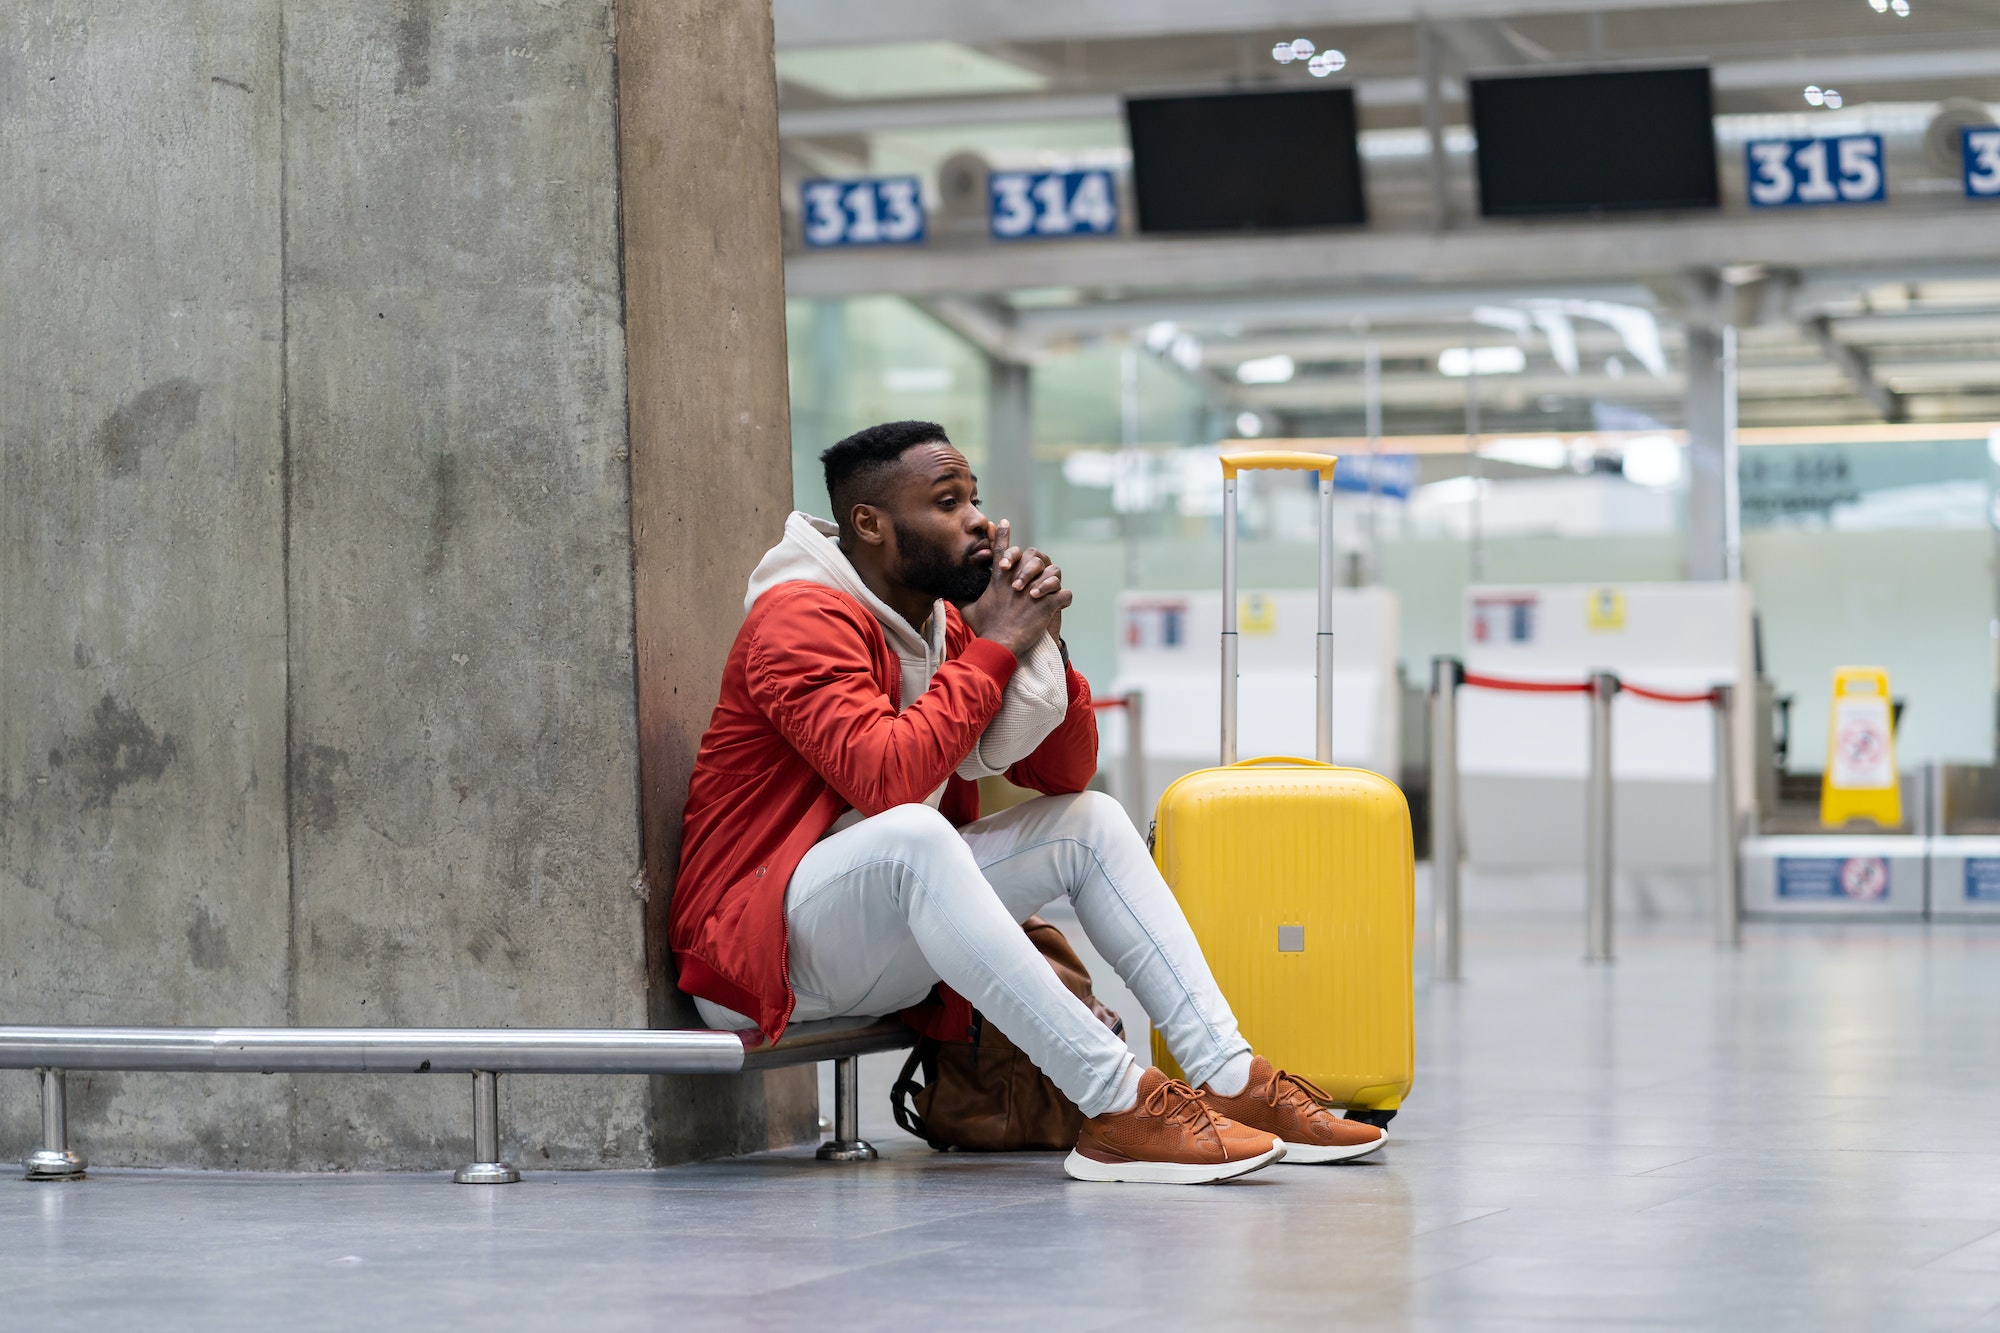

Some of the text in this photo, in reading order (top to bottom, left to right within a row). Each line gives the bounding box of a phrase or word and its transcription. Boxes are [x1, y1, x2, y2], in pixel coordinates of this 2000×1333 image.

[1751, 139, 1880, 204] 315
[805, 183, 921, 243] 313
[993, 174, 1112, 234] 314
